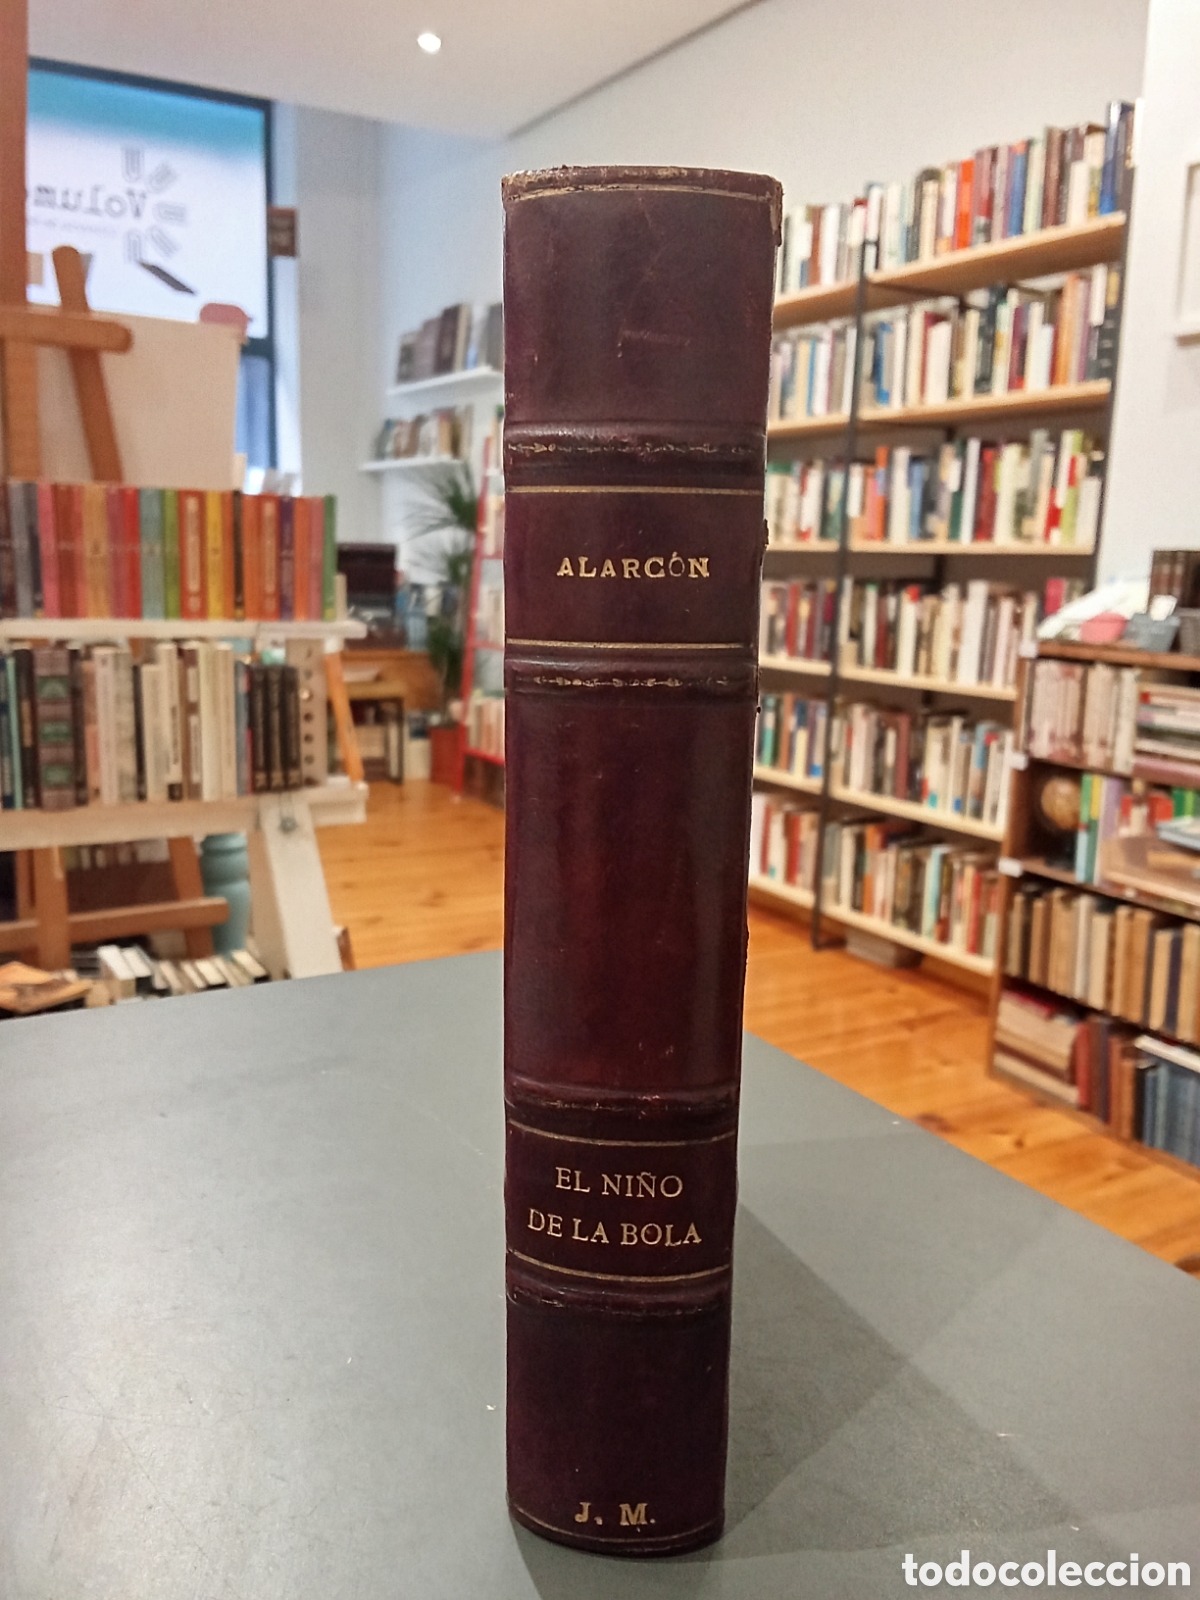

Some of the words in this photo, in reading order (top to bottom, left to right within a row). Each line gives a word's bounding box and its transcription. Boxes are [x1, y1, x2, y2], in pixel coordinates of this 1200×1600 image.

[556, 551, 710, 579] ALARCÓN
[555, 1166, 590, 1193] EL
[601, 1171, 683, 1198] NIÑO
[527, 1208, 563, 1238] DE
[572, 1217, 609, 1244] LA
[620, 1222, 702, 1247] BOLA
[574, 1501, 603, 1526] J.
[619, 1502, 656, 1526] M.
